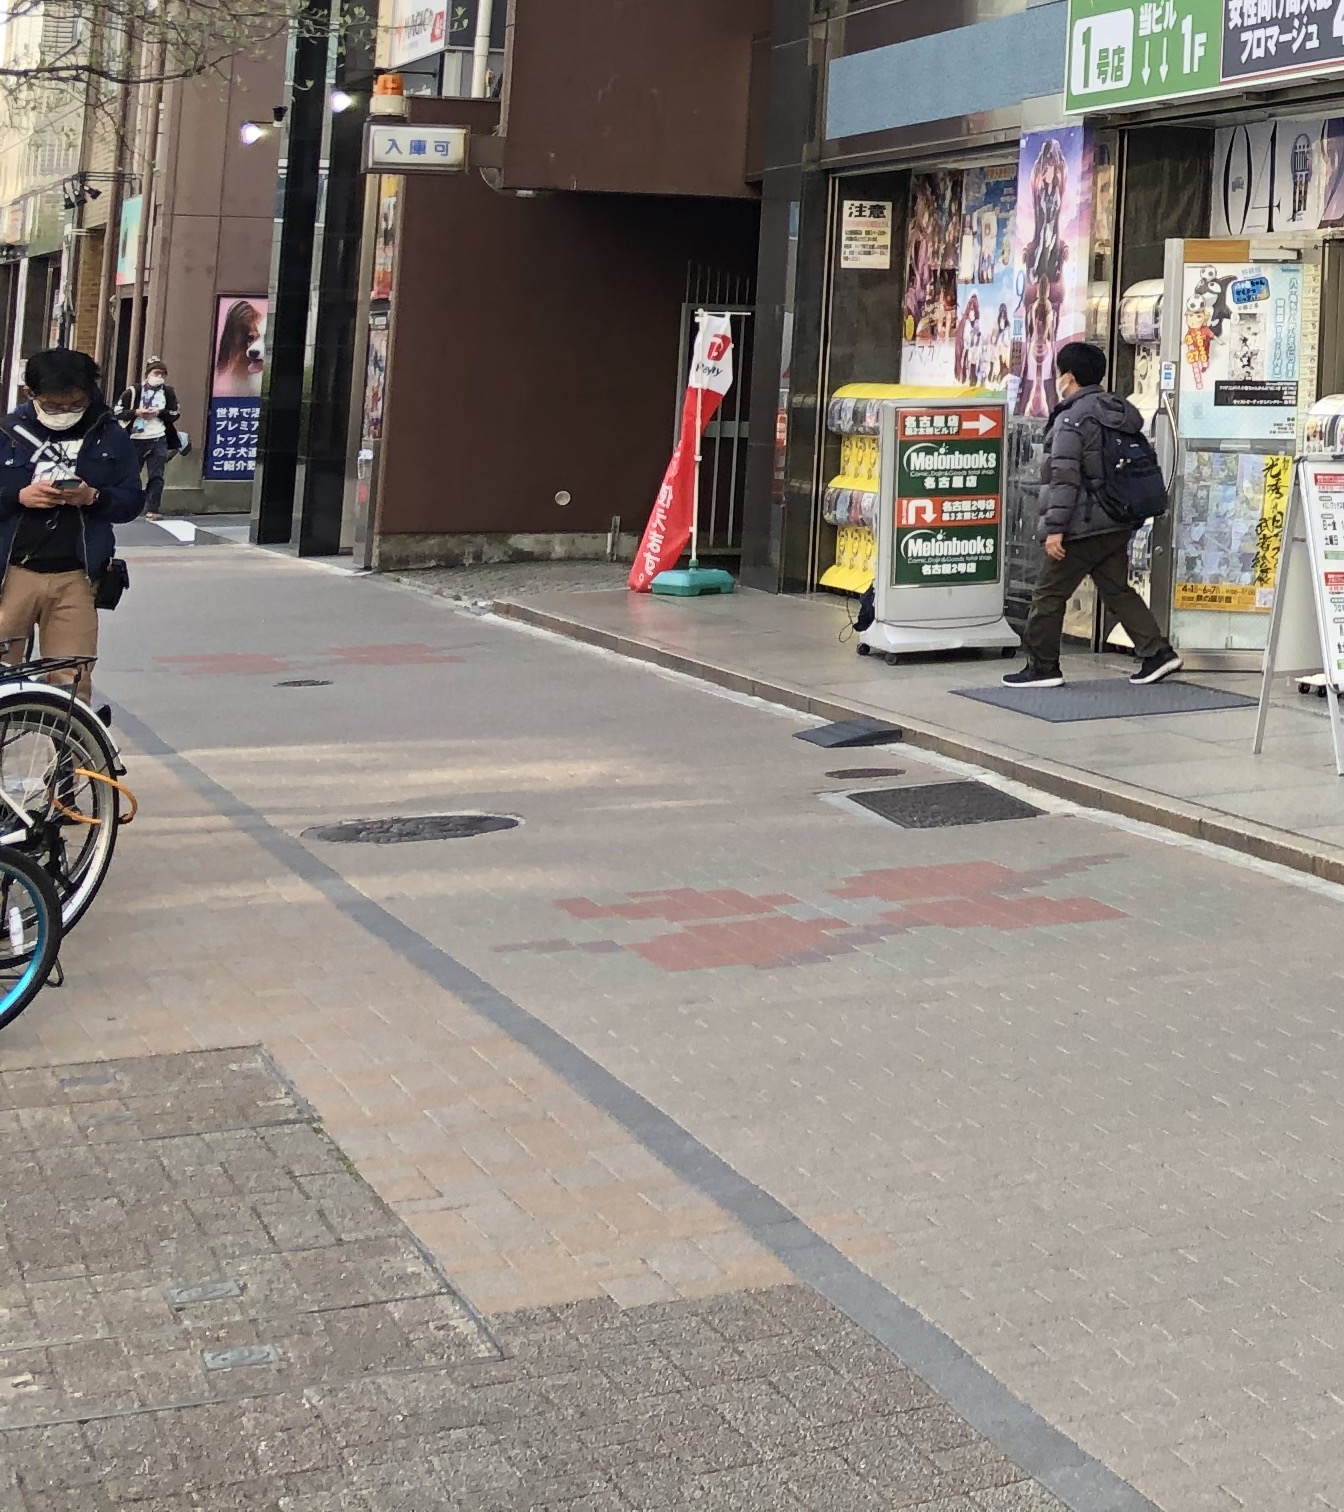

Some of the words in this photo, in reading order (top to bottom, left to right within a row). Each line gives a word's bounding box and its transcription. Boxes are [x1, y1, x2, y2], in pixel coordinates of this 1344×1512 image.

[1138, 0, 1178, 37] 当ビル
[1181, 13, 1207, 75] 1F
[1239, 16, 1321, 64] フロマージュ
[1081, 24, 1126, 92] 1号店
[385, 139, 451, 158] 入庫可
[848, 203, 887, 219] 注意
[905, 415, 960, 427] 名古屋店
[910, 450, 997, 471] Melonbooks
[923, 475, 978, 489] 名古屋店
[941, 499, 996, 512] 名古屋2号店
[907, 536, 995, 558] Melonbooks
[921, 562, 977, 576] 名古屋2号店
